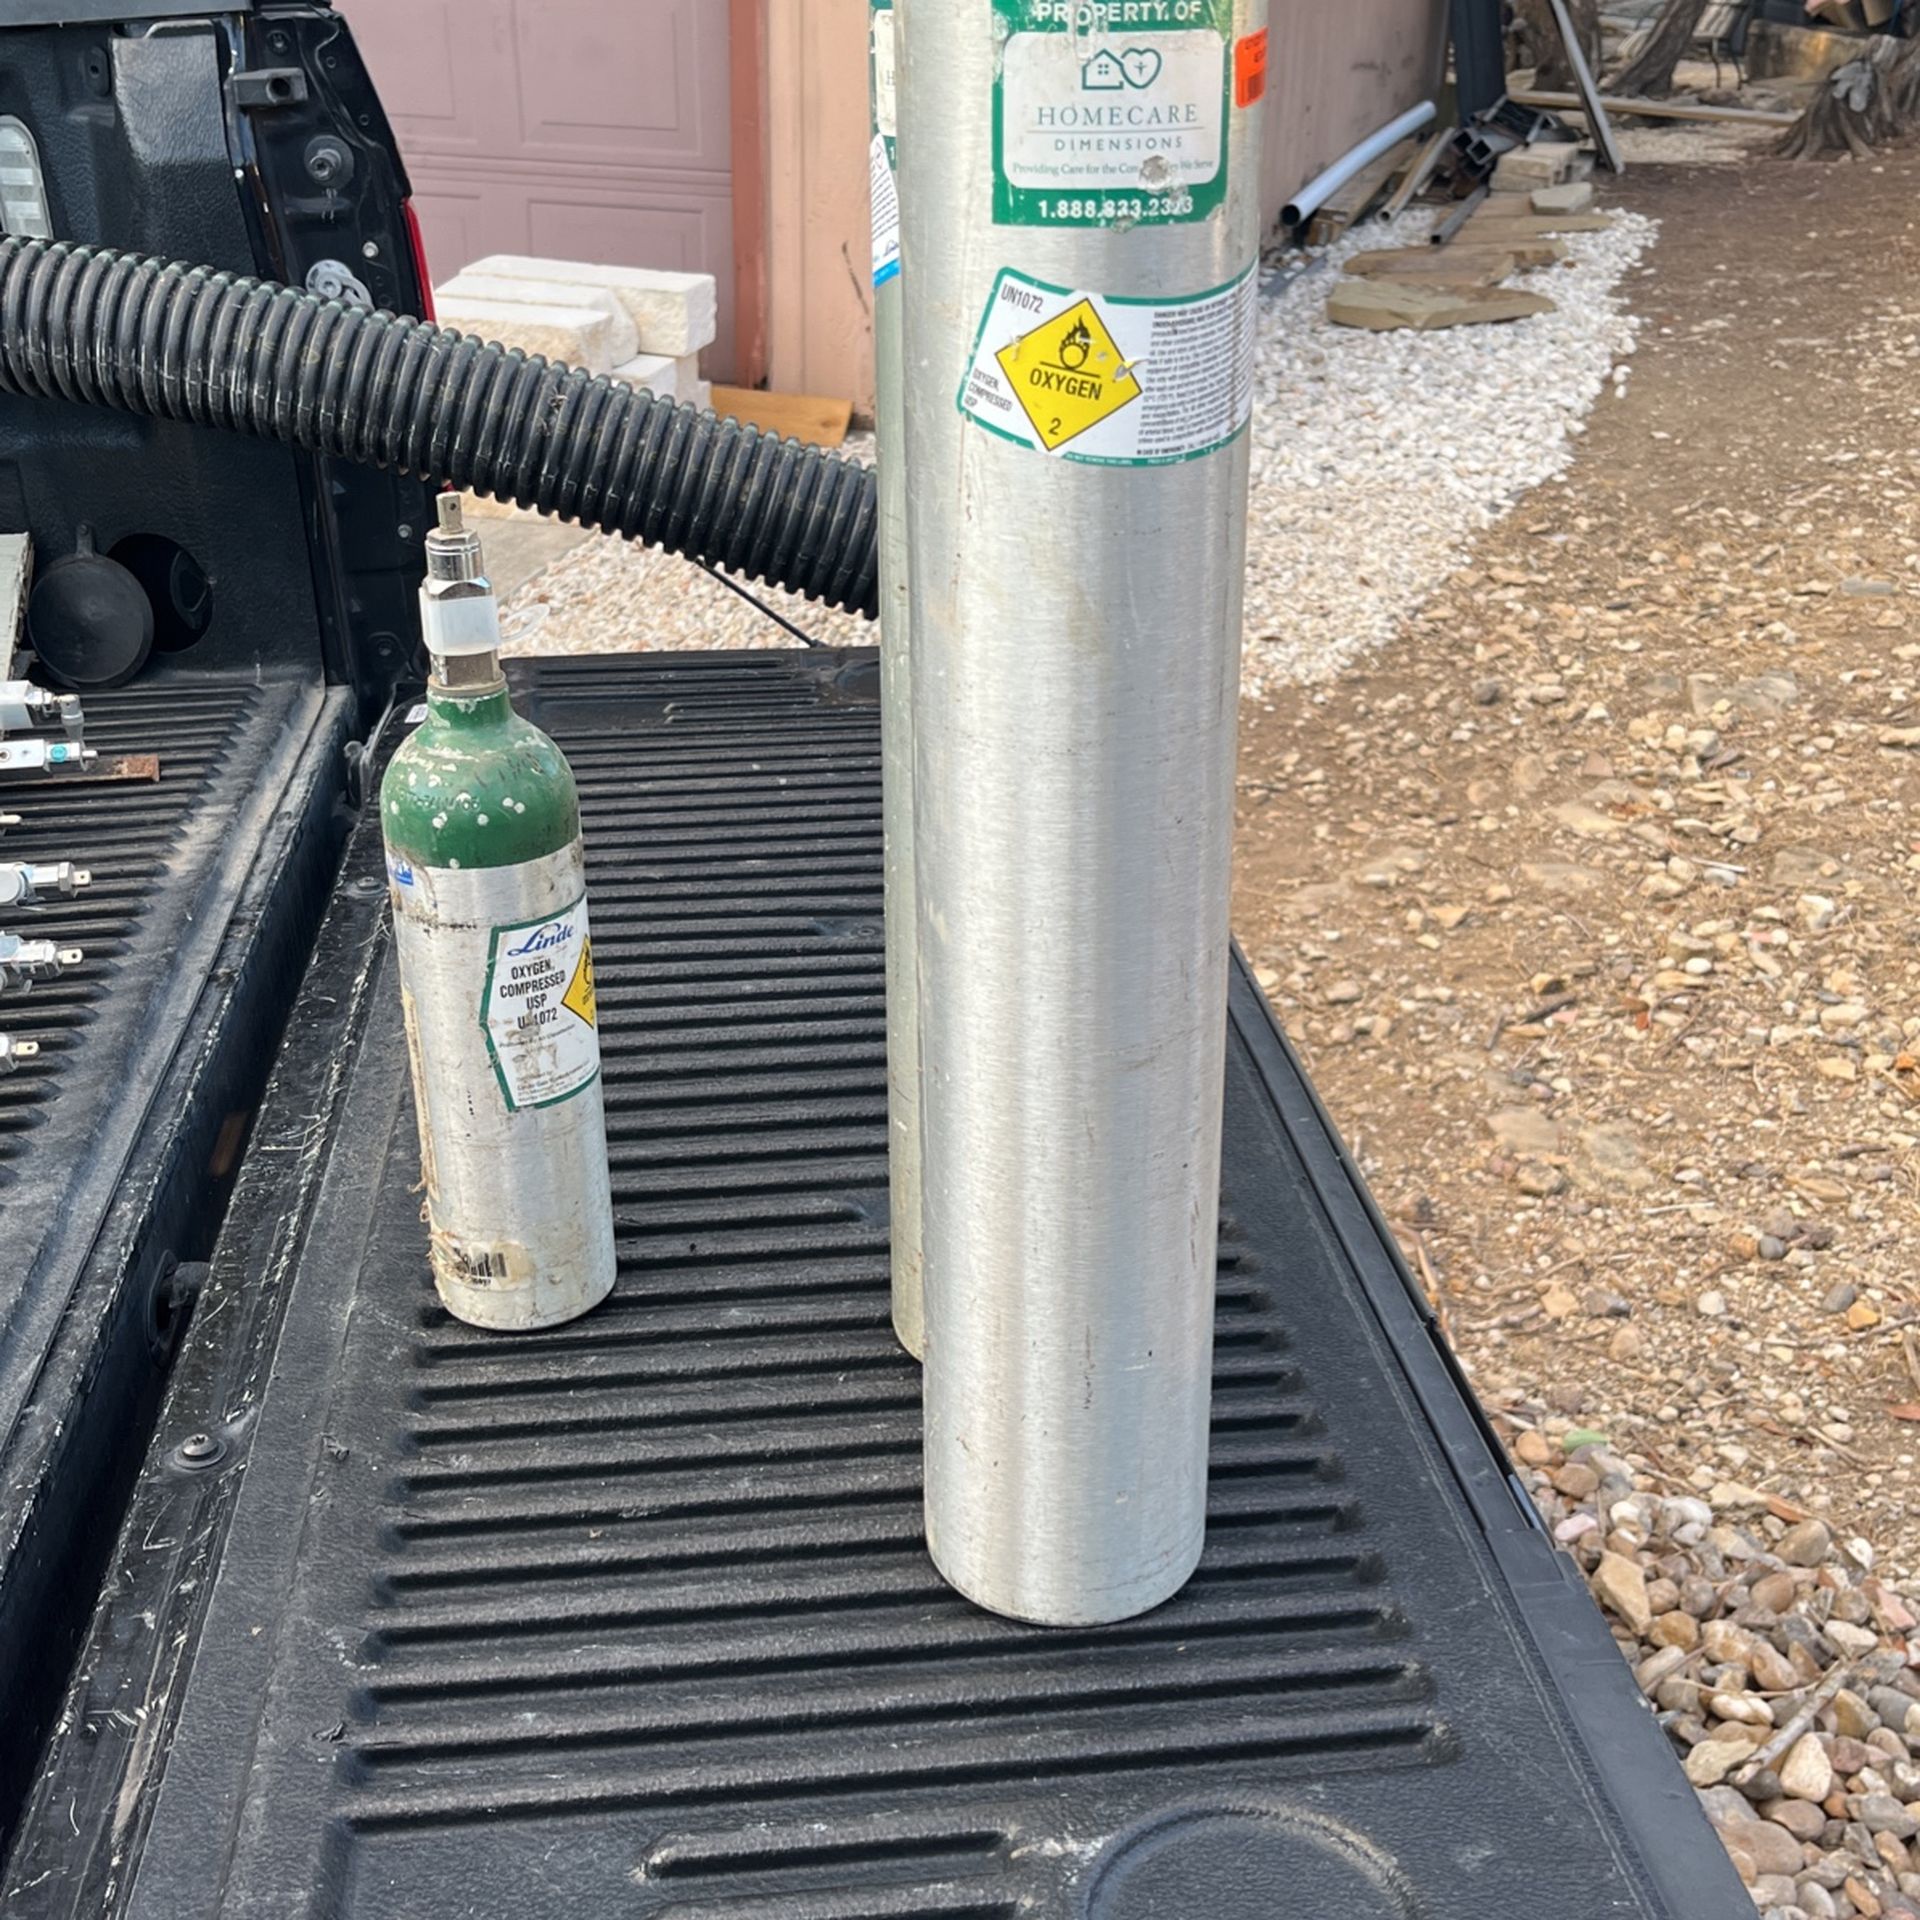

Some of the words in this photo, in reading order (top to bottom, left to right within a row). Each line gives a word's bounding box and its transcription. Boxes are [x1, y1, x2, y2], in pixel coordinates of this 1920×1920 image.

[1174, 0, 1202, 21] OF
[1037, 104, 1199, 126] HOMECARE
[1054, 136, 1183, 151] DIMENSIONS
[1012, 162, 1060, 177] Providing
[1060, 163, 1084, 174] Care
[1086, 163, 1100, 174] for
[1102, 163, 1117, 174] the
[1001, 284, 1044, 314] UN1072
[1029, 368, 1102, 401] OXYGEN
[968, 382, 1013, 412] COMPRESSED
[1049, 417, 1062, 436] 2
[507, 922, 575, 957] Linde
[500, 969, 566, 999] COMPRESSED
[526, 993, 548, 1011] USP
[517, 1007, 558, 1030] U1072
